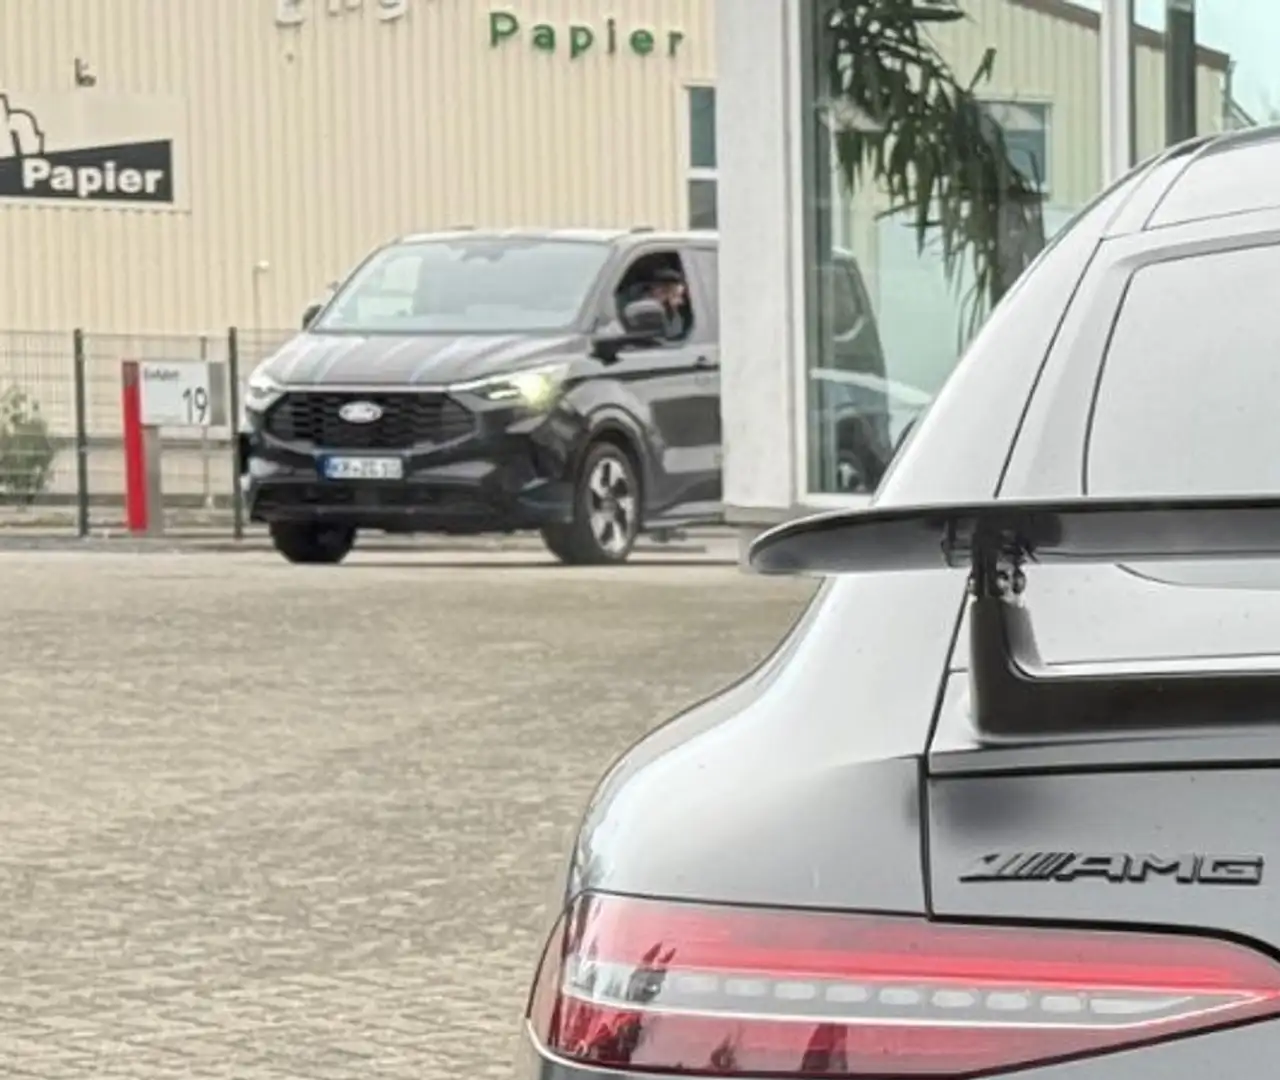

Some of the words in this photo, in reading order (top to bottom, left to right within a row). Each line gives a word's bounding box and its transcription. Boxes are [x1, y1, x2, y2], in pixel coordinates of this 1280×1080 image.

[489, 11, 684, 59] Papier
[22, 157, 164, 198] Papier
[182, 387, 208, 424] 19
[1053, 852, 1265, 885] AMG
